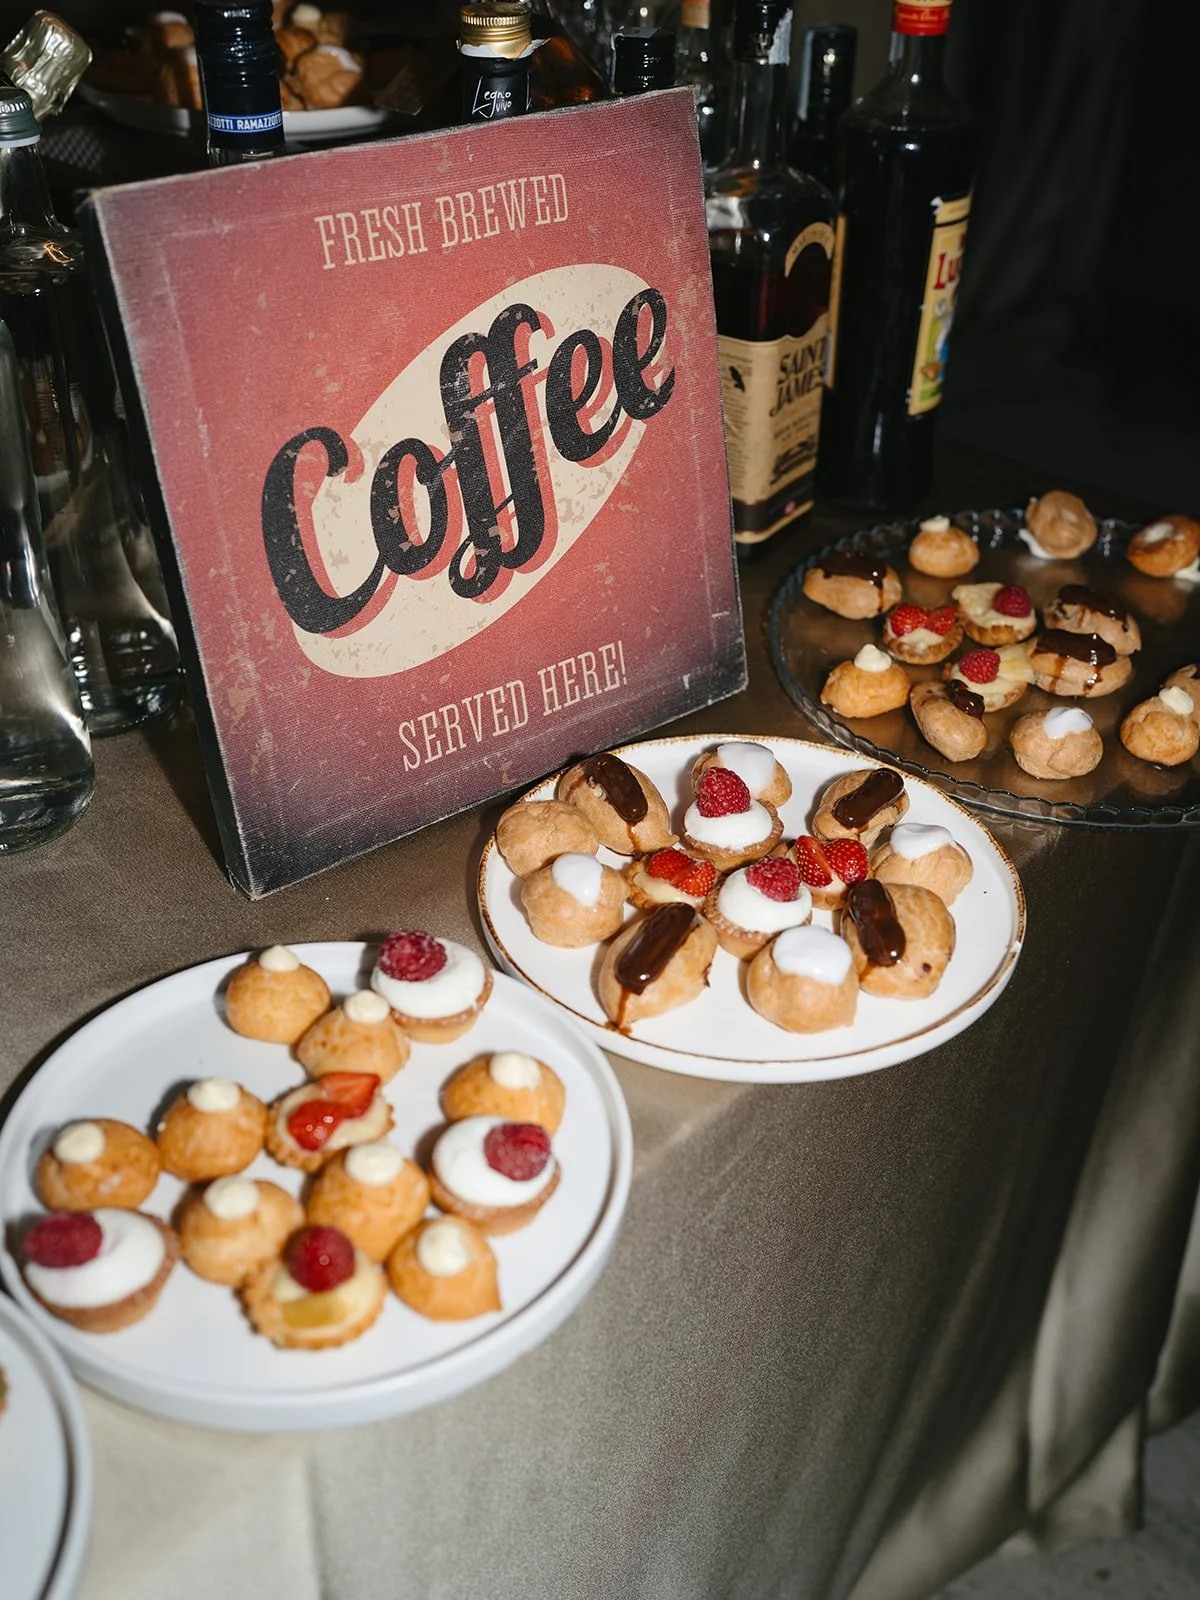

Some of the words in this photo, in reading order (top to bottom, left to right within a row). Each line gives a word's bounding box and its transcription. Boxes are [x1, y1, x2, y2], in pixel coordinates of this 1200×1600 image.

[472, 76, 512, 118] Legno
[314, 202, 428, 270] FRESH
[435, 173, 569, 248] BREWED
[261, 288, 676, 637] Coffee
[398, 679, 529, 771] SERVED
[537, 640, 628, 716] HERE!
